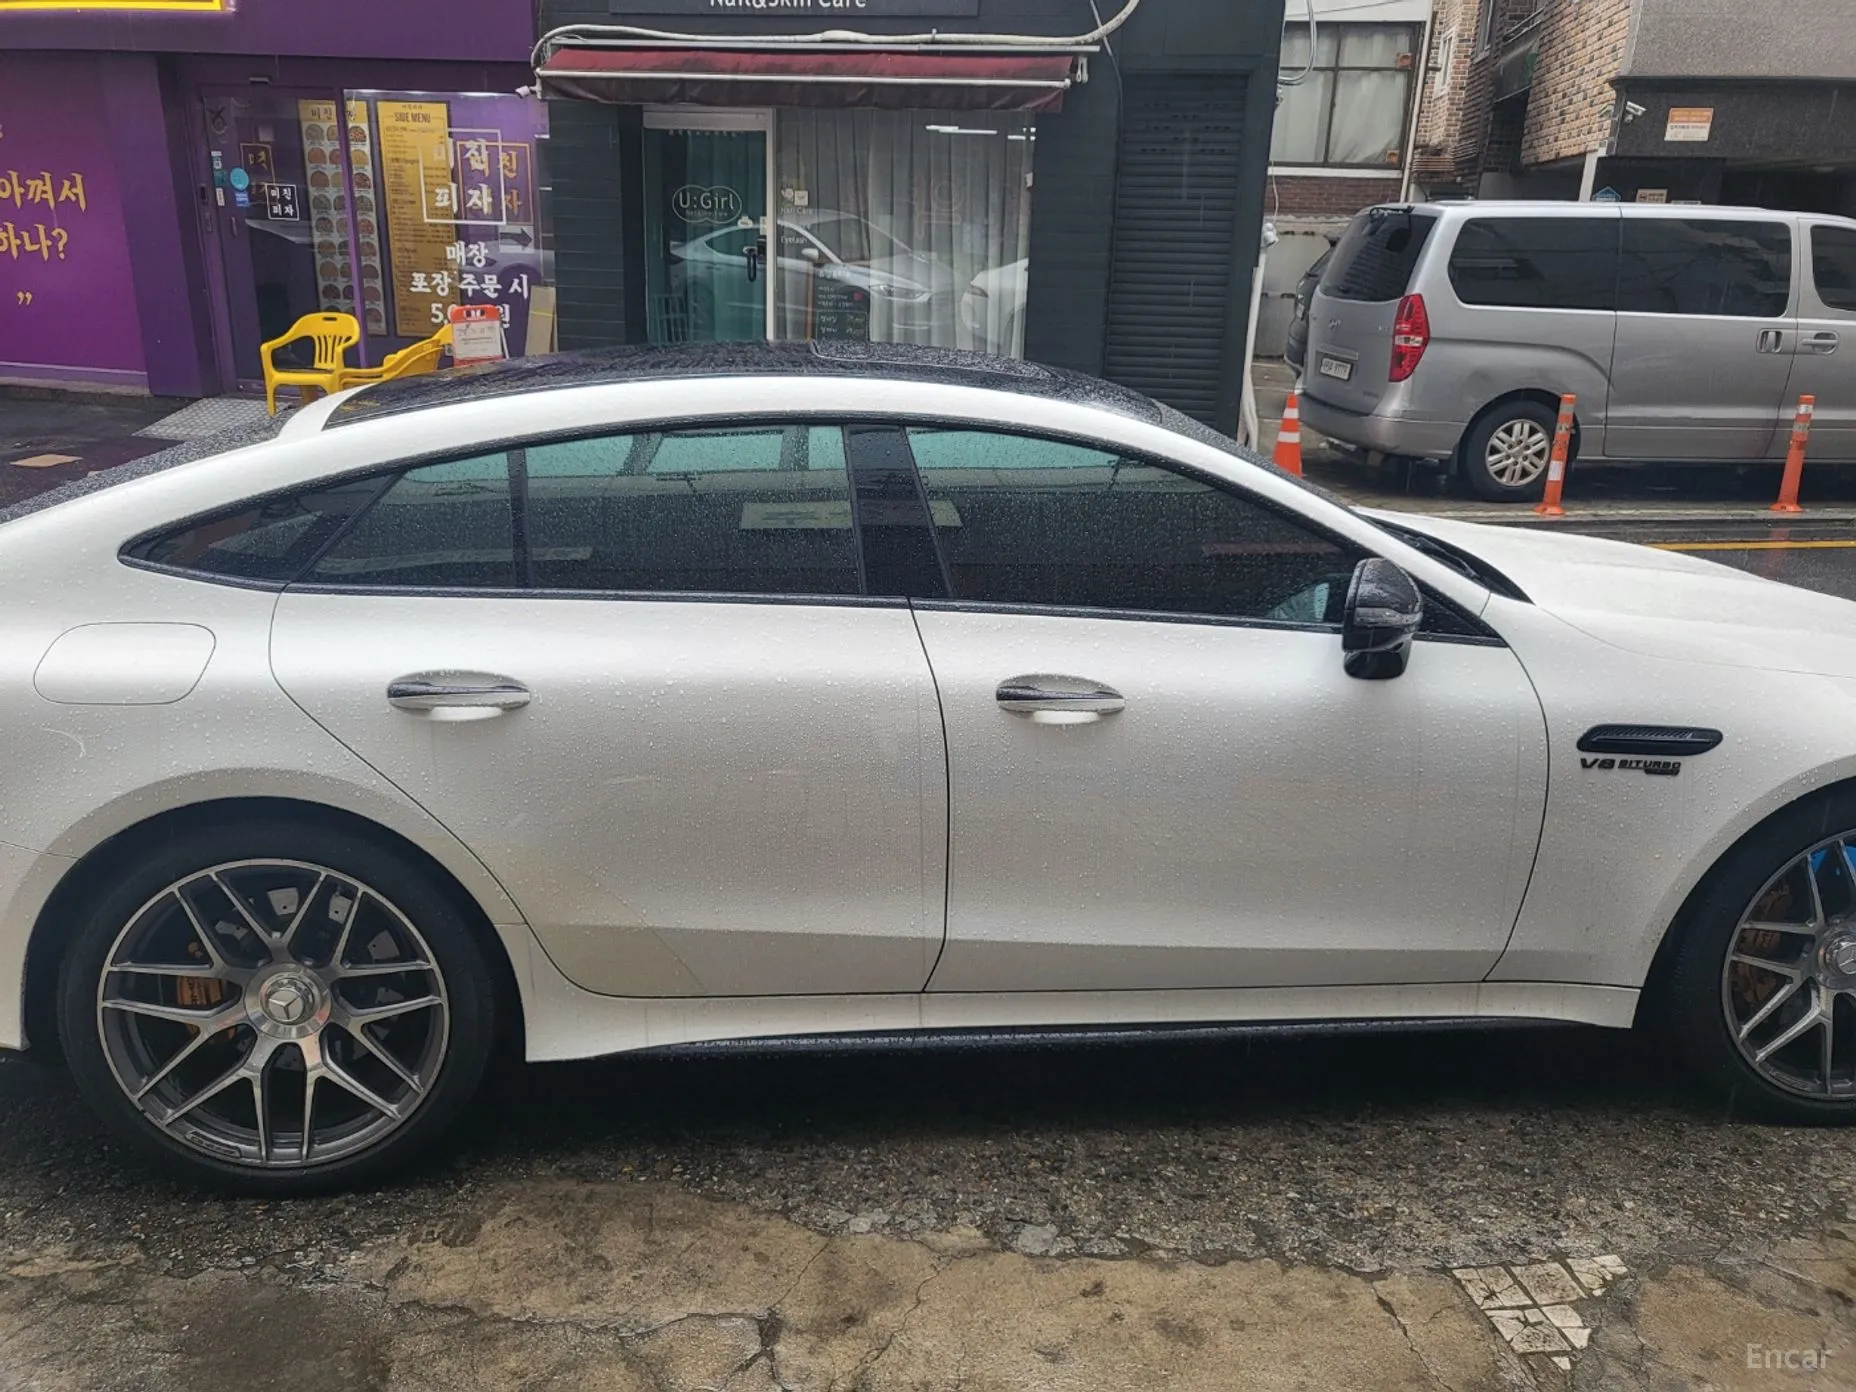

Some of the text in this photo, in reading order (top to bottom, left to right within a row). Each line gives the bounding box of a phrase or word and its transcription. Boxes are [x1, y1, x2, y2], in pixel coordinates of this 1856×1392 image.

[411, 112, 431, 124] MENU
[0, 170, 87, 213] 아껴서
[435, 183, 493, 215] 피자
[446, 240, 489, 268] 매장
[409, 270, 529, 300] 포장 주문 시
[1580, 757, 1682, 770] V8 BITURBO
